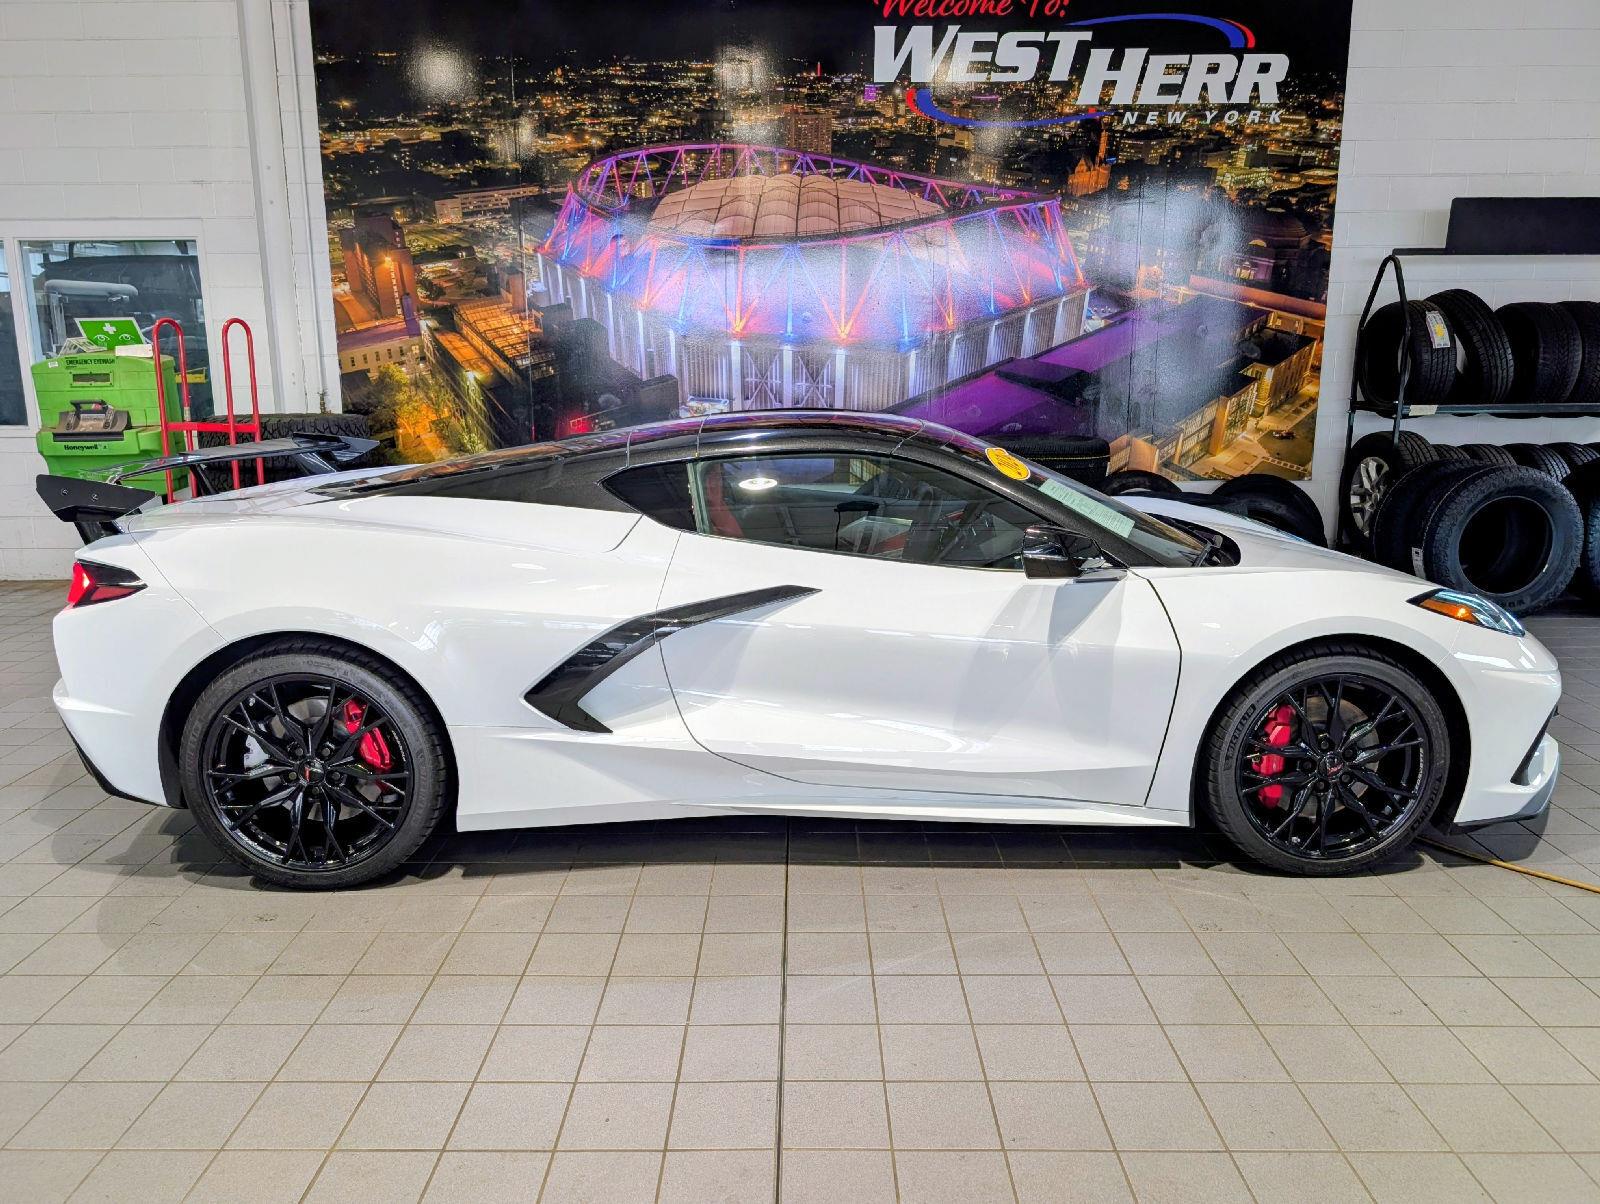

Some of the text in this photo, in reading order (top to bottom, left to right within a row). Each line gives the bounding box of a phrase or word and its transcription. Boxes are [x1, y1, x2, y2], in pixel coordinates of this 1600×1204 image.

[872, 0, 1013, 18] Welcome
[874, 25, 1290, 105] WEST HERR
[1123, 110, 1285, 125] NEW YORK
[65, 358, 92, 366] EMERGENCY
[64, 444, 99, 452] Honeywell
